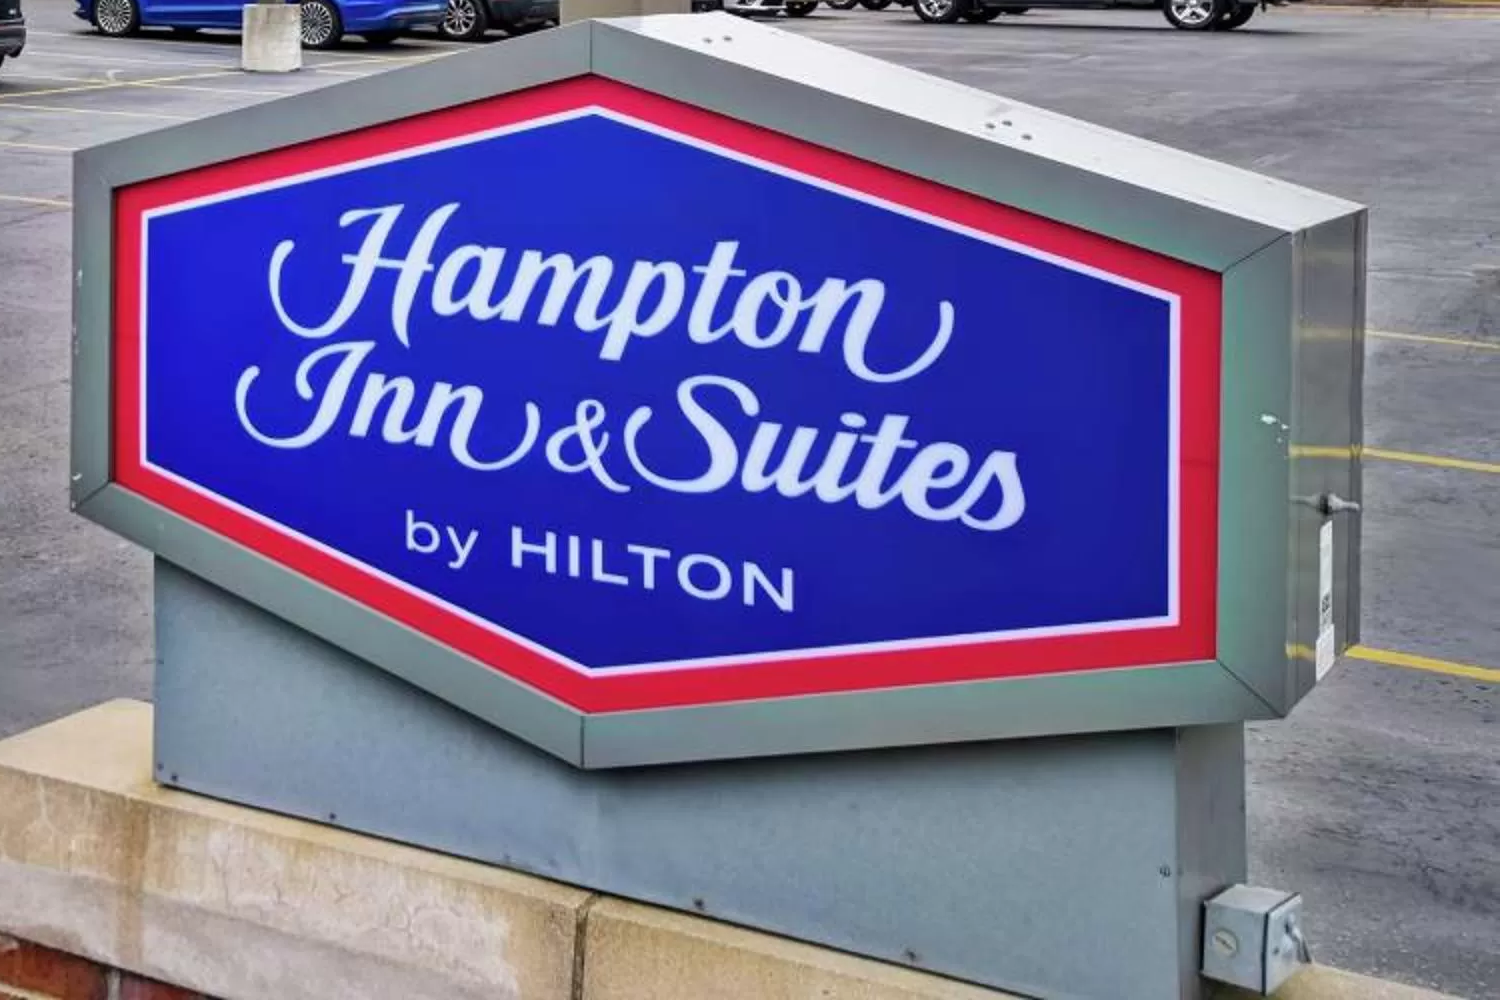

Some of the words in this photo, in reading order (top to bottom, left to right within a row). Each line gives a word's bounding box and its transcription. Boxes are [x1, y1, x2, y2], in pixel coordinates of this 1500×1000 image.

[267, 202, 955, 383] Hampton
[235, 340, 540, 471] Inn
[546, 398, 630, 493] &
[624, 374, 1026, 531] Suites
[405, 510, 479, 569] by
[510, 526, 795, 612] HILTON
